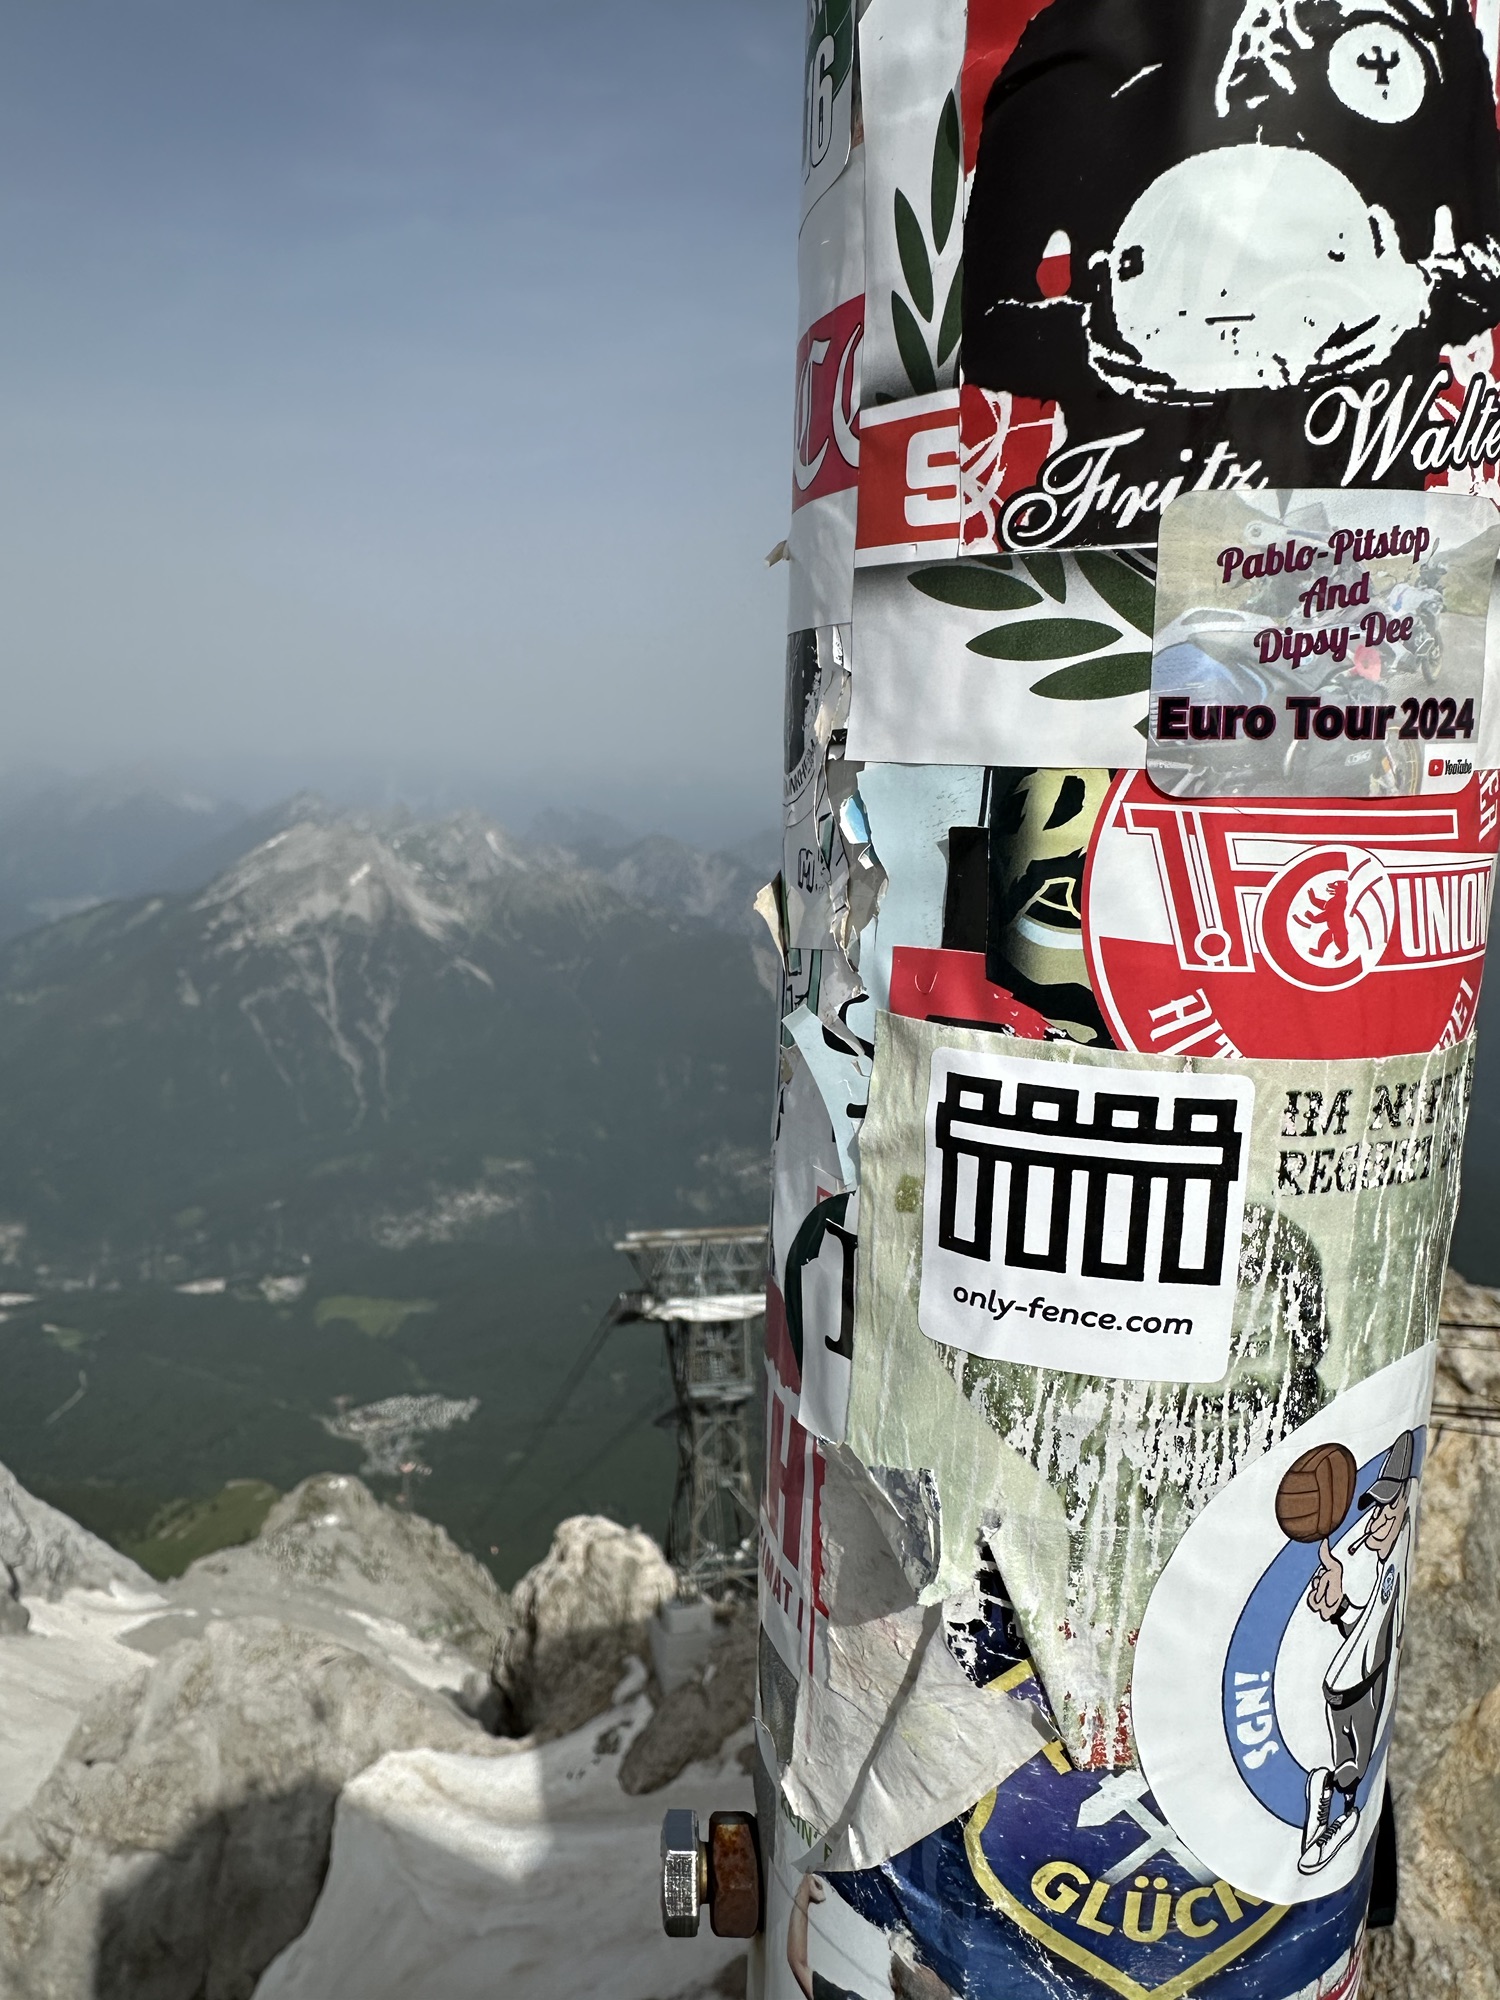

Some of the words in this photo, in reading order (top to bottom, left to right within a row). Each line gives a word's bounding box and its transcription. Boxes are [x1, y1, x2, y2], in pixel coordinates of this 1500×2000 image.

[1216, 524, 1430, 584] Pablo-Pitstop
[1299, 571, 1371, 618] And
[1253, 611, 1414, 670] Dipsy-Dee
[1156, 696, 1277, 740] Euro
[1286, 696, 1395, 740] Tour
[1399, 697, 1475, 740] 2024
[1445, 758, 1472, 775] YouTube
[1396, 870, 1490, 958] UNION
[1281, 1089, 1354, 1137] IM
[953, 1286, 1194, 1335] only-fence.com
[1234, 1670, 1280, 1769] SGN!
